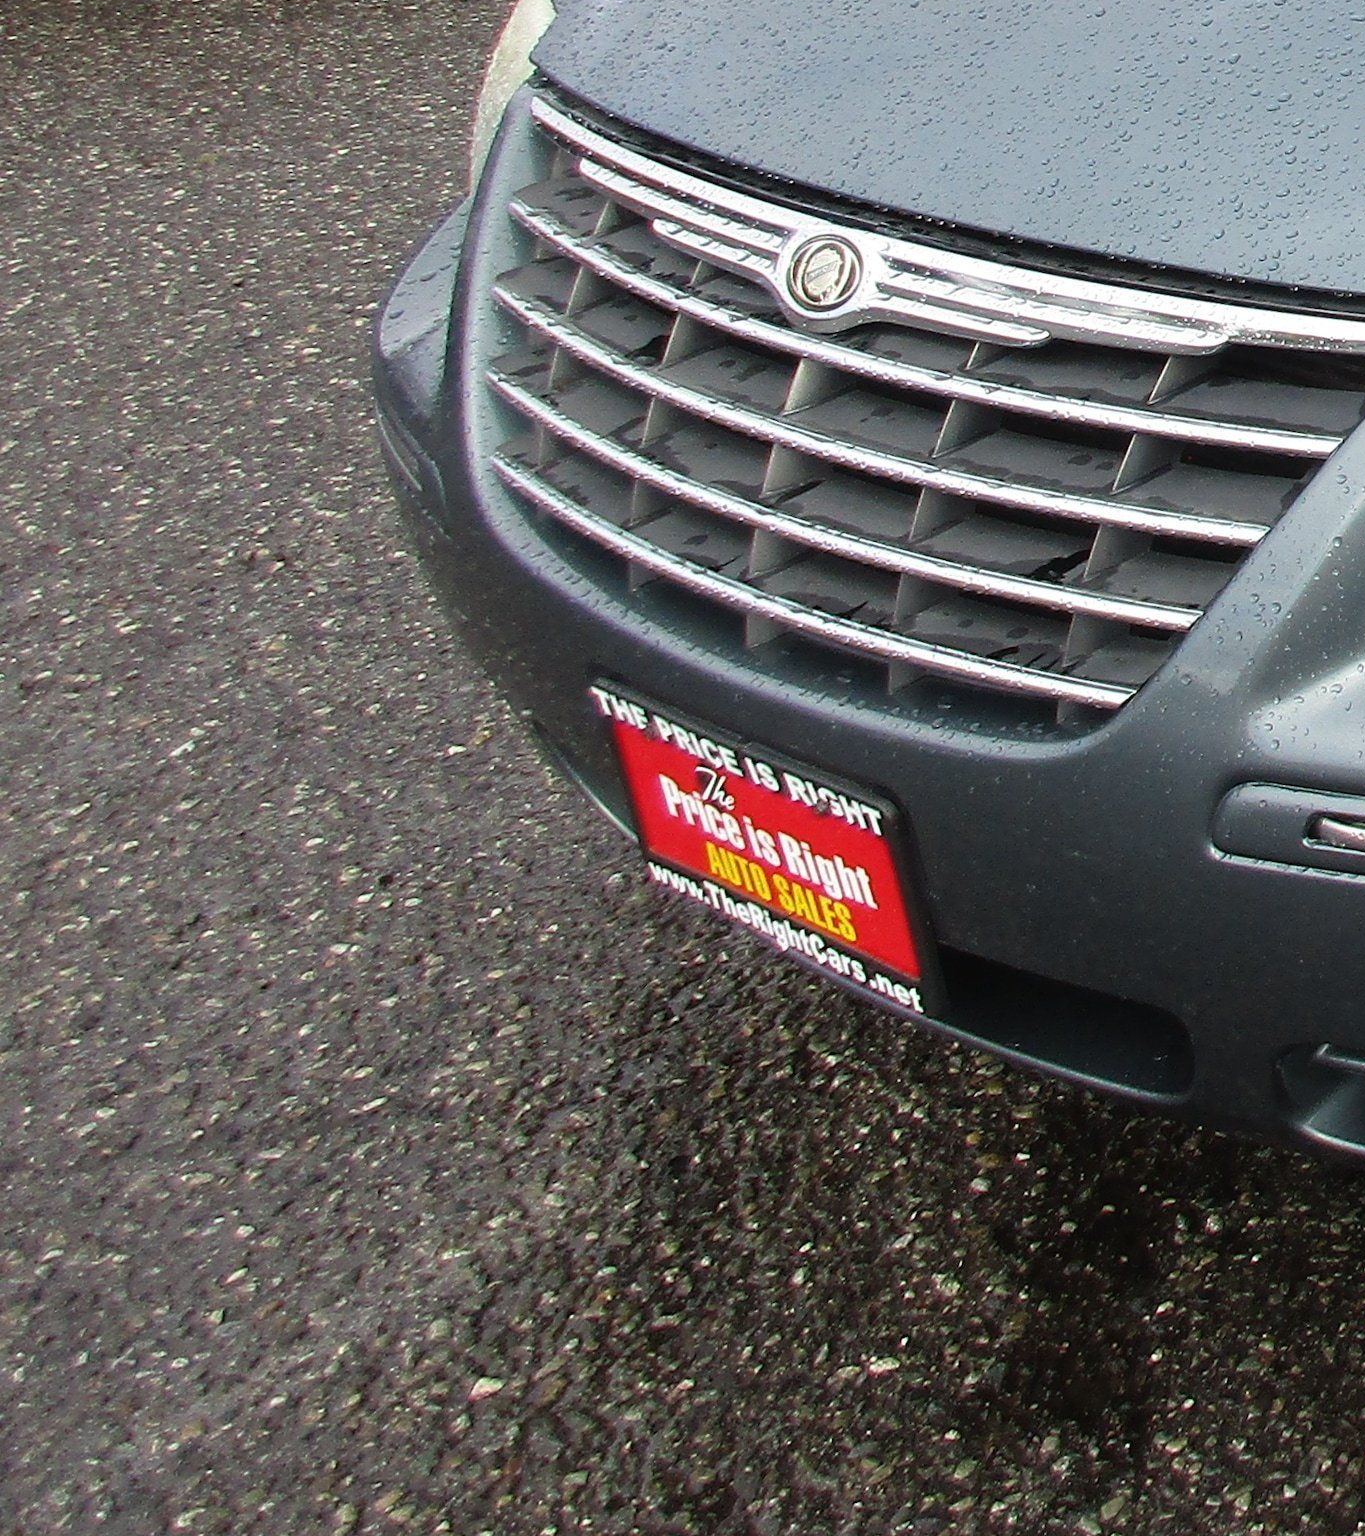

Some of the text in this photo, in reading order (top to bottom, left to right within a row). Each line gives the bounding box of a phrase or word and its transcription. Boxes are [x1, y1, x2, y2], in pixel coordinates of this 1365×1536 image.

[589, 686, 883, 836] THE PRICE IS RIGHT
[695, 766, 736, 811] The
[658, 773, 878, 910] Price is Right
[706, 841, 858, 942] AUTO SALES
